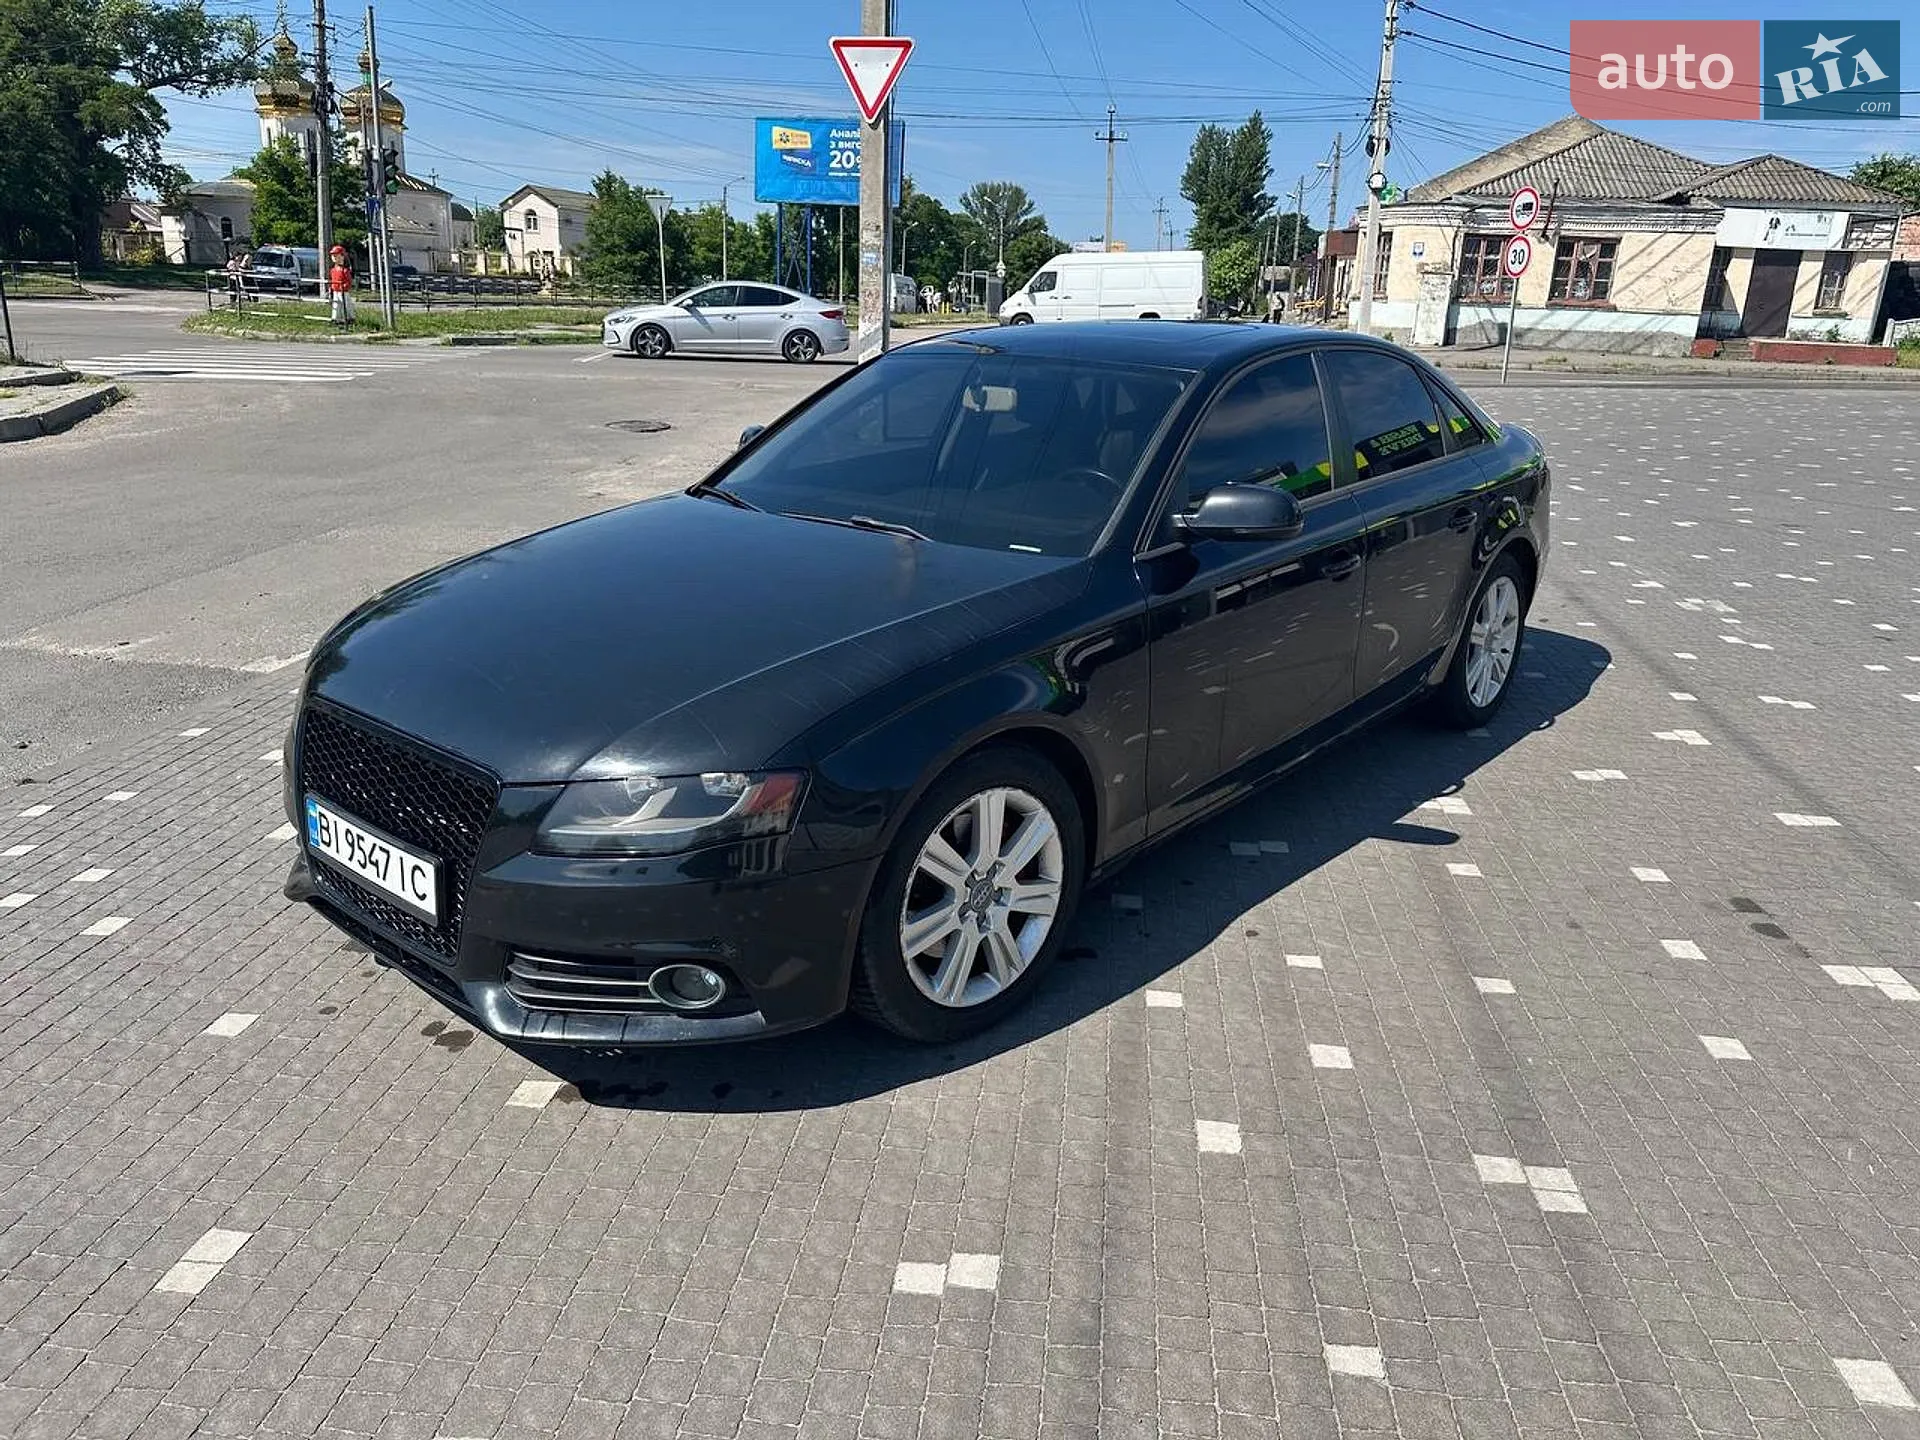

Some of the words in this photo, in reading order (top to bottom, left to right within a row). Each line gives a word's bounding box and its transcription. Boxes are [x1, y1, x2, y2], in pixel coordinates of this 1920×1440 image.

[1510, 248, 1525, 265] 30
[319, 811, 339, 854] BI
[345, 828, 391, 881] 9547
[400, 855, 427, 901] IC
